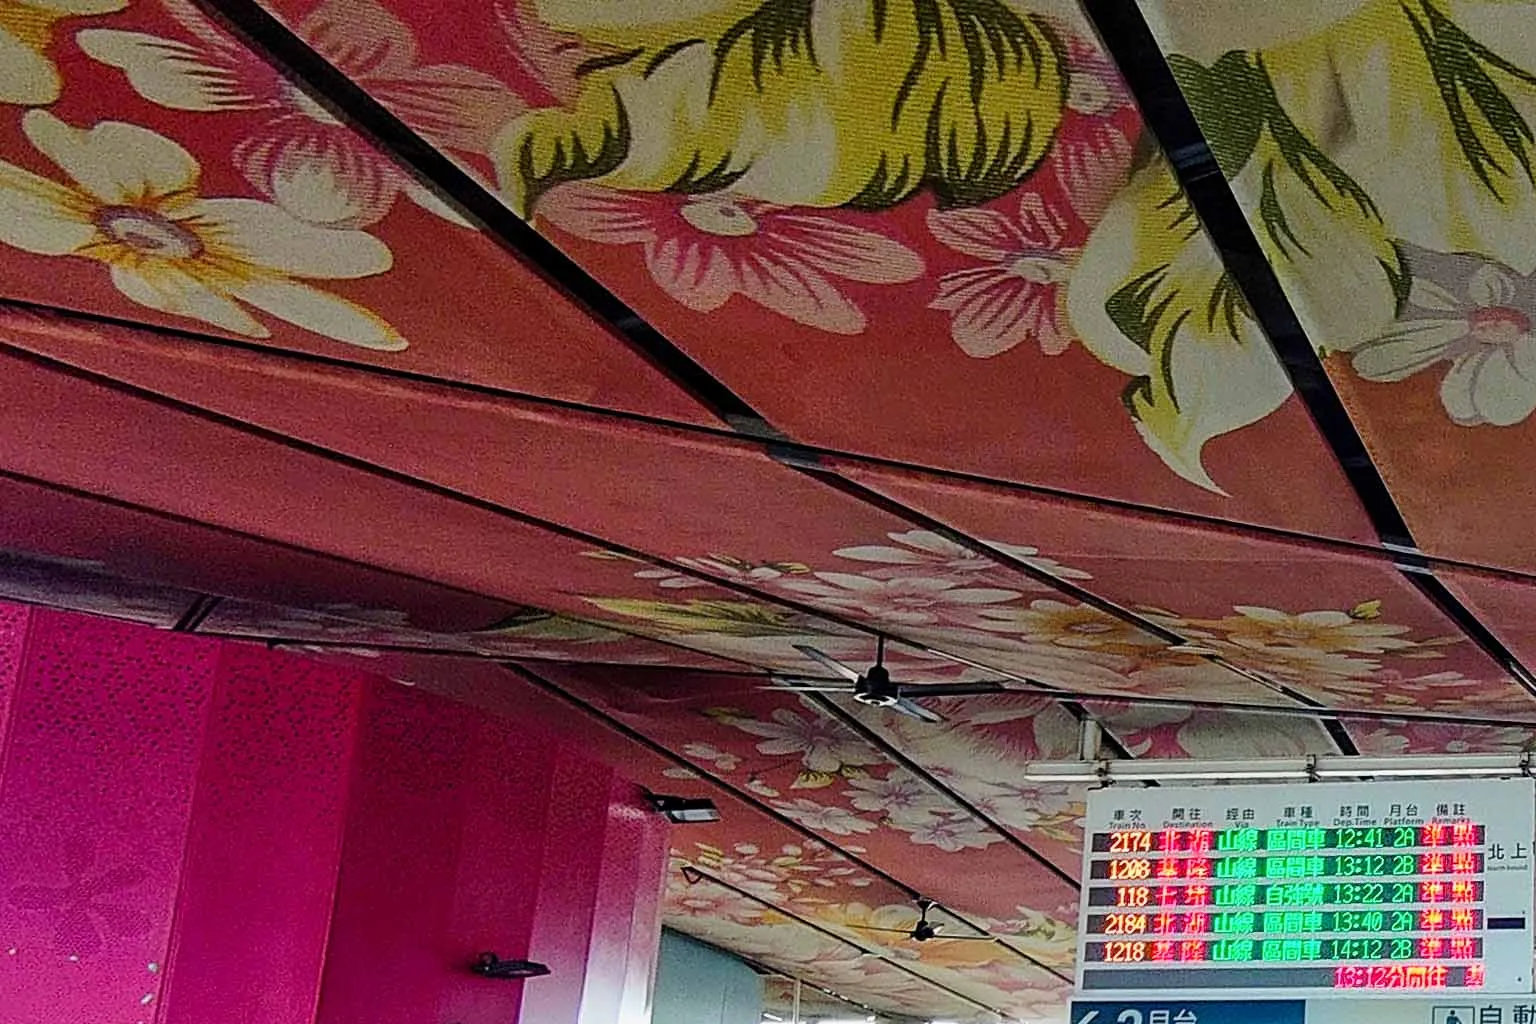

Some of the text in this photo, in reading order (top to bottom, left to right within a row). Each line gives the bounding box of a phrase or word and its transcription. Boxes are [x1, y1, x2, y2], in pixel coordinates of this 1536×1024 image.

[1114, 803, 1466, 821] 車次 開往 經由 車種 時間 月台 備註
[1384, 817, 1424, 825] Platform
[1110, 832, 1151, 852] 2174
[1218, 830, 1258, 850] 山線
[1267, 829, 1326, 850] 區間車
[1336, 828, 1384, 848] 12:41
[1394, 827, 1414, 847] 2A
[1488, 843, 1527, 860] 北上
[1109, 859, 1150, 879] 1208
[1217, 857, 1257, 878] 山線
[1266, 857, 1325, 877] 區間車
[1335, 856, 1384, 875] 13:12
[1393, 855, 1414, 874] 2B
[1117, 886, 1149, 906] 118
[1215, 885, 1255, 905] 山線
[1265, 884, 1324, 905] 自強號
[1334, 884, 1384, 903] 13:22
[1392, 883, 1413, 903] 2A
[1105, 914, 1146, 934] 2184
[1214, 912, 1254, 933] 山線
[1264, 912, 1322, 933] 區間車
[1333, 912, 1383, 931] 13:40
[1391, 911, 1413, 931] 2A
[1104, 941, 1145, 962] 1218
[1213, 940, 1253, 961] 山線
[1262, 939, 1321, 960] 區間車
[1331, 939, 1381, 959] 14:12
[1391, 939, 1412, 959] 2B
